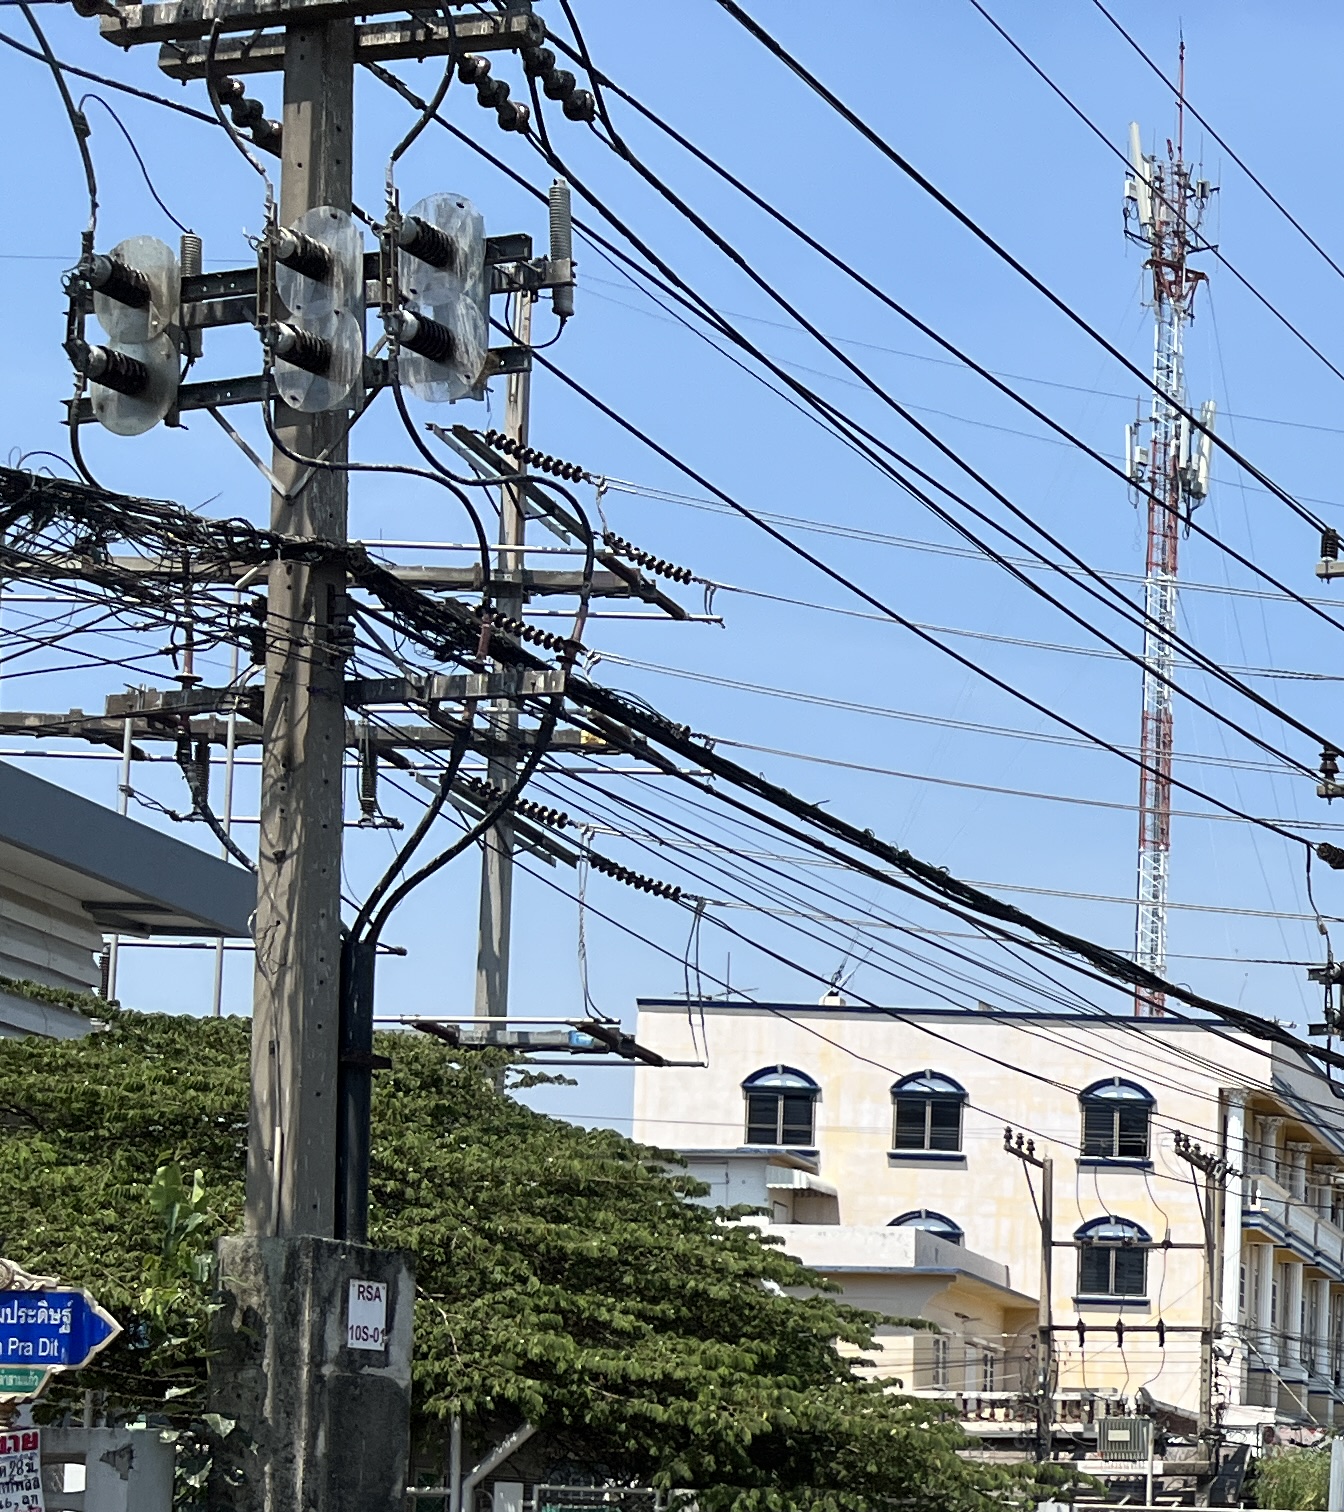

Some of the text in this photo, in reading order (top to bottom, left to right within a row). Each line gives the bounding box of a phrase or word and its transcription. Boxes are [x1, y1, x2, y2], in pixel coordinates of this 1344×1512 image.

[357, 1284, 383, 1302] RSA
[7, 1337, 59, 1357] Pra Dit
